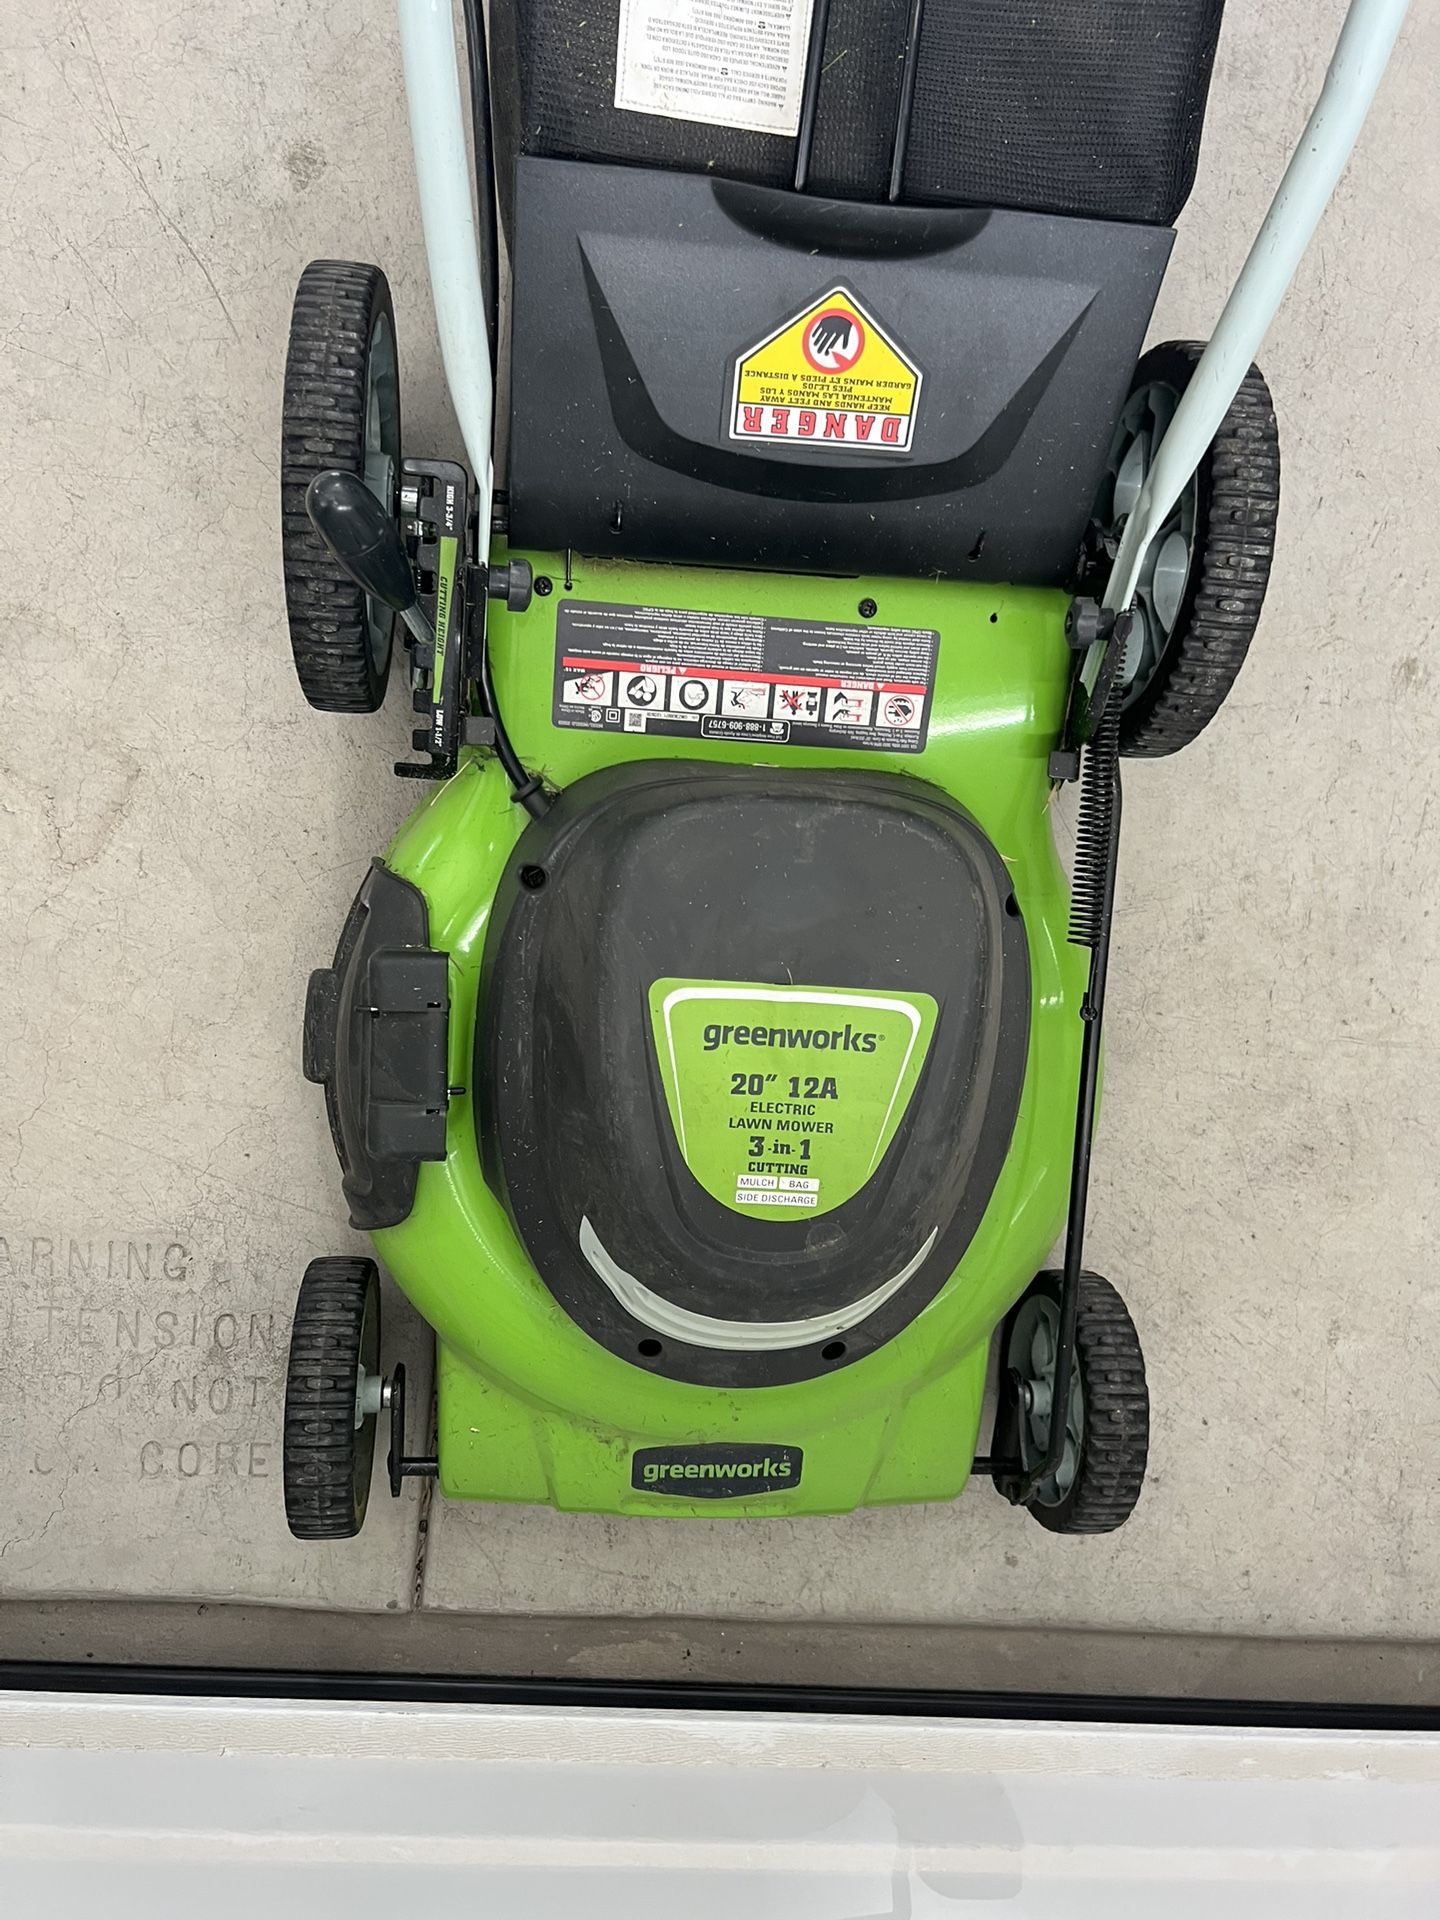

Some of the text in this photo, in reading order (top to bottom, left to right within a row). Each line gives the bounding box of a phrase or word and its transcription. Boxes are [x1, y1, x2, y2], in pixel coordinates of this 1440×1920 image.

[744, 370, 788, 379] DISTANCE
[800, 374, 826, 382] PIEDS
[802, 382, 829, 390] LEJOS
[843, 378, 873, 386] MAINS
[875, 380, 911, 389] GARDER
[759, 394, 785, 402] AWAY
[787, 389, 819, 398] MANOS
[841, 393, 892, 403] MANTENGA
[834, 400, 864, 409] HANDS
[867, 403, 890, 411] KEEP
[742, 406, 901, 442] DANGER
[446, 485, 454, 504] HIGH
[437, 576, 448, 656] CUTTING HEIGHT
[639, 663, 676, 673] PELIGRO
[840, 680, 873, 689] DANGER
[436, 710, 444, 726] LOW
[708, 719, 765, 732] 1-888-909-6757
[704, 1024, 877, 1052] greenworks
[730, 1074, 838, 1099] 20" 12A
[750, 1102, 816, 1116] ELECTRIC
[729, 1117, 834, 1134] LAWN MOWER
[748, 1162, 808, 1176] CUTTING
[740, 1178, 810, 1190] MULCH BAG
[737, 1193, 816, 1205] SIDE DISCHARGE
[37, 1306, 274, 1351] TENSION
[170, 1376, 270, 1415] NOT
[140, 1440, 272, 1478] CORE
[644, 1458, 791, 1482] greenworks
